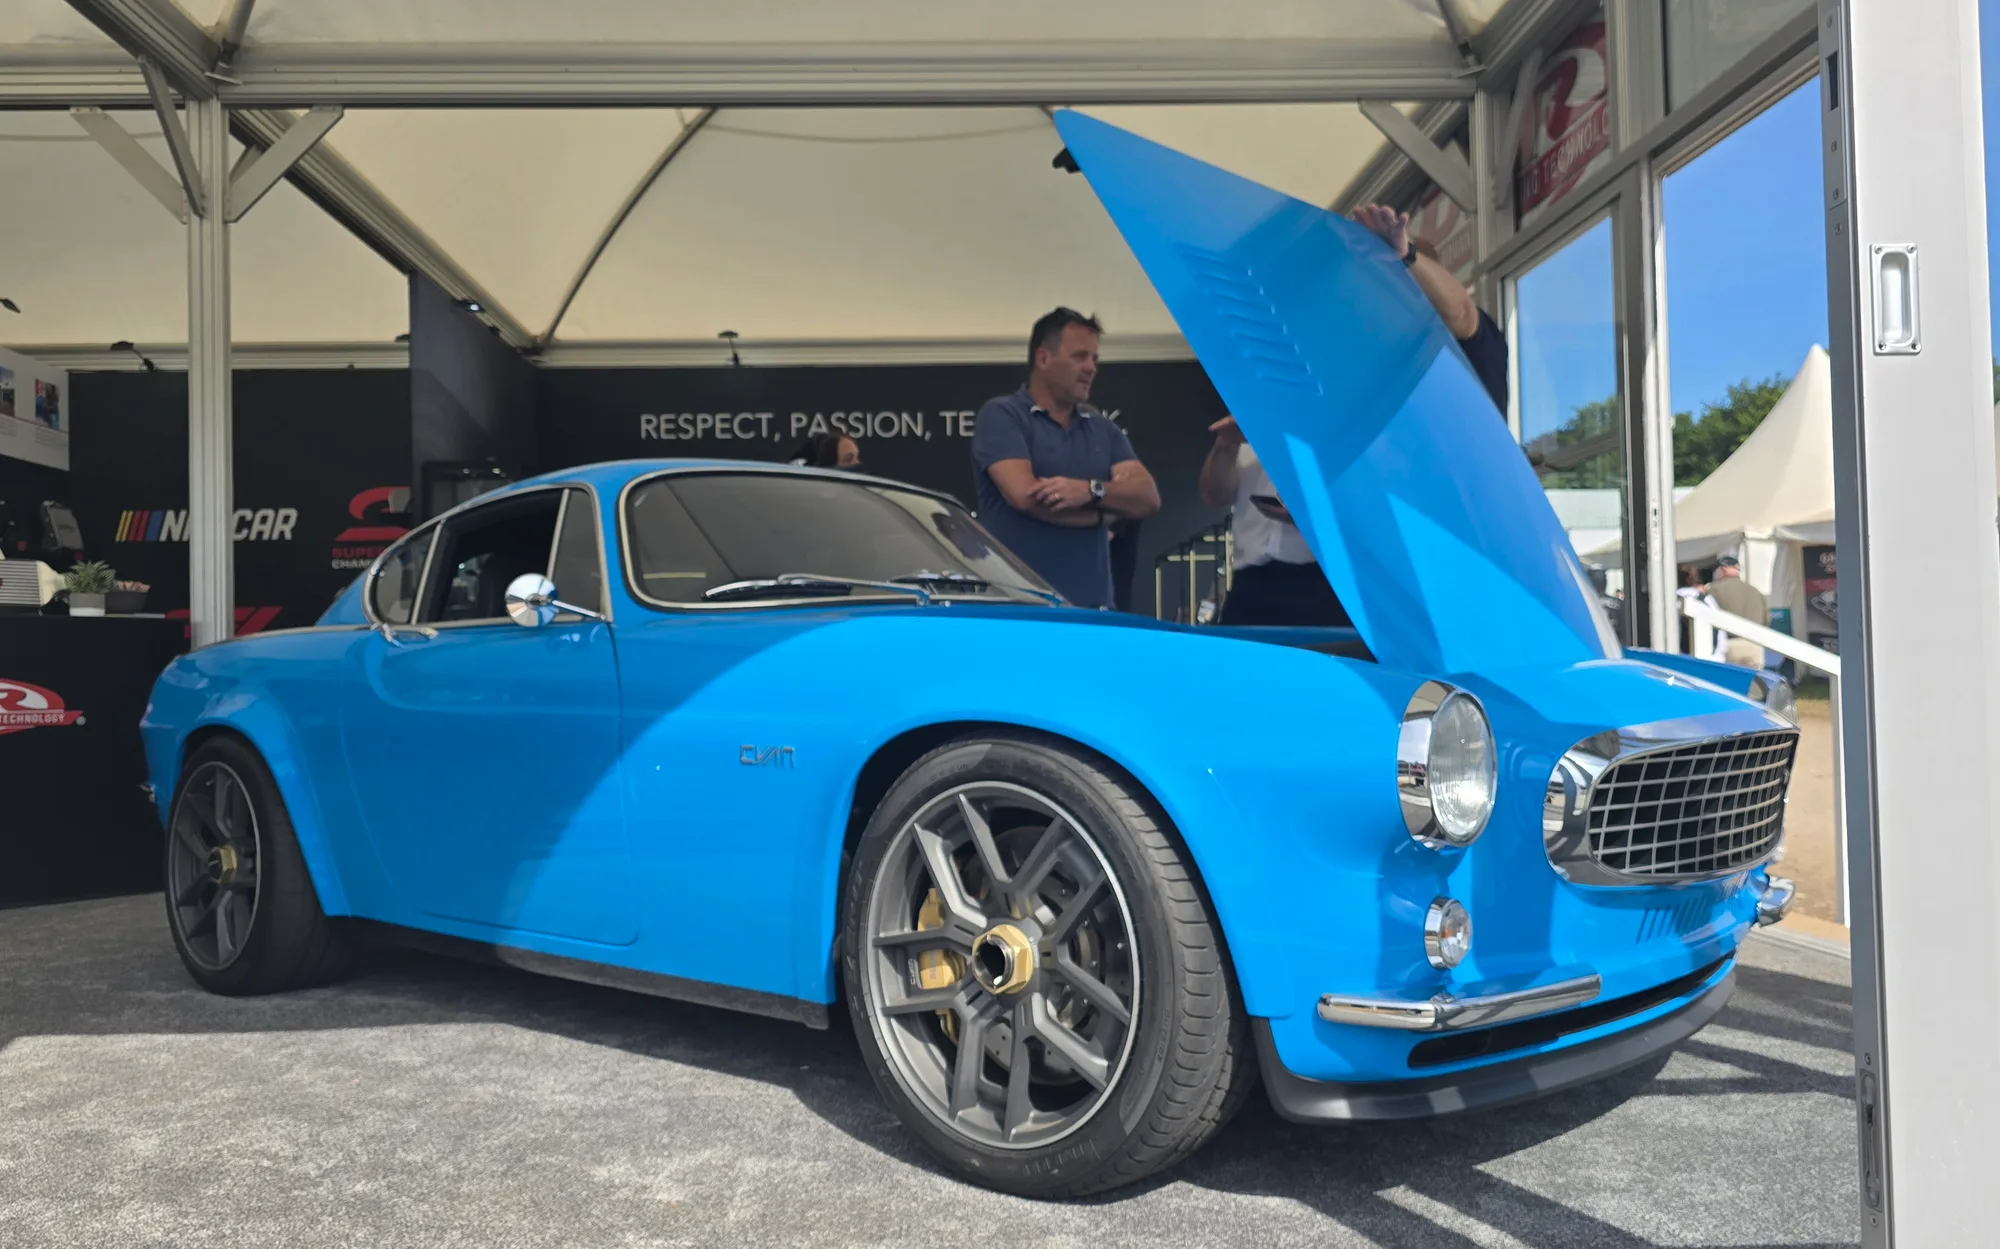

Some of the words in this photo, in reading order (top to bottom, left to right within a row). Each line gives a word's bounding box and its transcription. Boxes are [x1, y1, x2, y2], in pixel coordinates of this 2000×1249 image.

[640, 412, 780, 442] RESPECT,
[790, 410, 931, 440] PASSION,
[158, 508, 298, 542] NCAR
